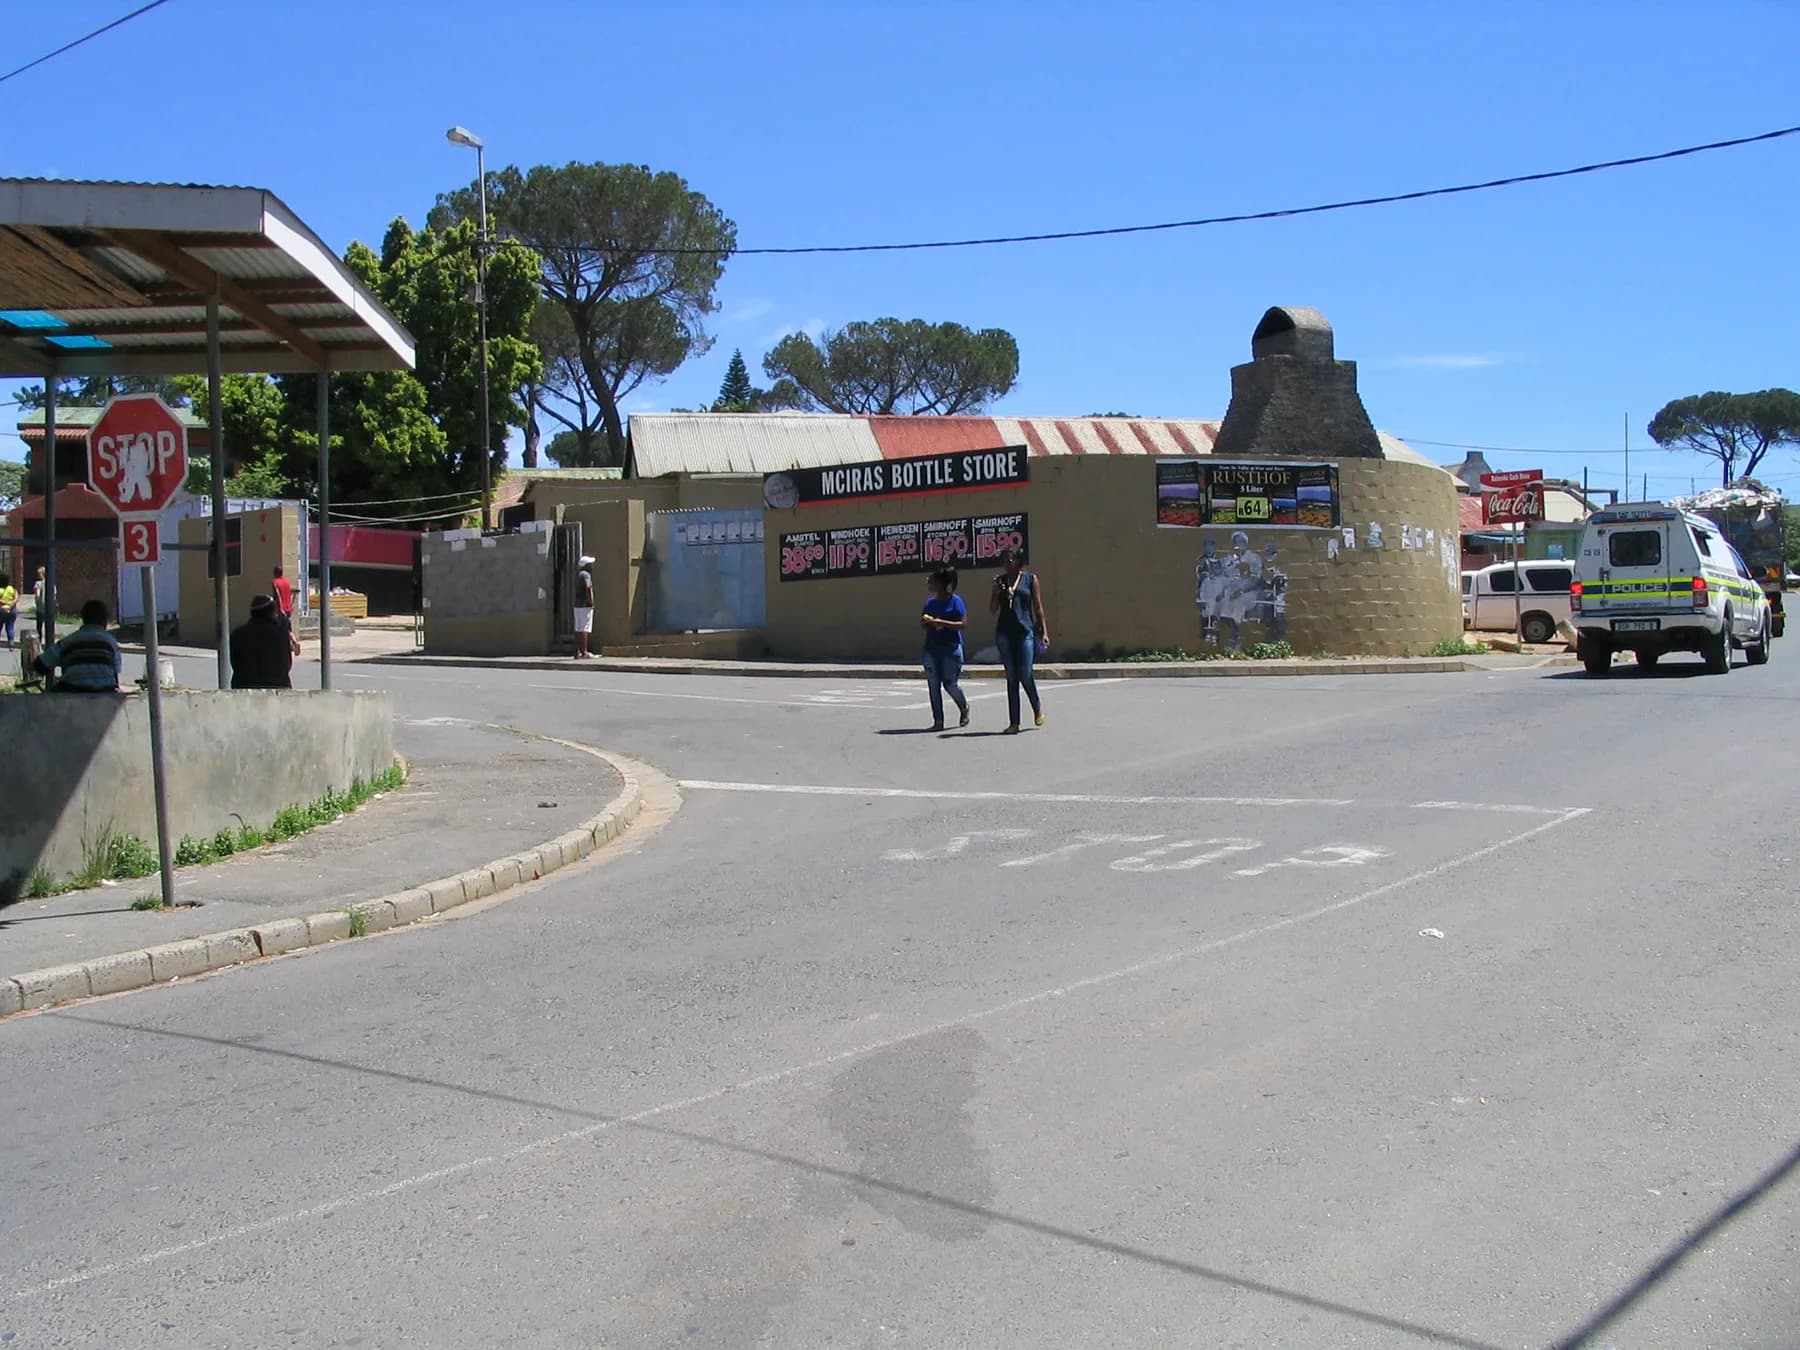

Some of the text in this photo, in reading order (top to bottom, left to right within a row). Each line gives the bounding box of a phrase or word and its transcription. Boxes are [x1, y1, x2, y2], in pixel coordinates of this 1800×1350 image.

[821, 464, 885, 496] MCIRAS
[891, 458, 954, 489] BOTTLE
[962, 451, 1018, 482] STORE
[1212, 470, 1292, 485] RUSTHOF
[1488, 490, 1539, 518] Coca-Cola
[923, 519, 968, 532] SMIRNOFF
[974, 515, 1022, 528] SMIRNOFF
[830, 527, 871, 540] WINDHOEK
[880, 523, 919, 536] HEINEKEN
[130, 523, 150, 560] 3
[785, 532, 821, 543] AMSTEL
[1611, 583, 1664, 594] POLICE
